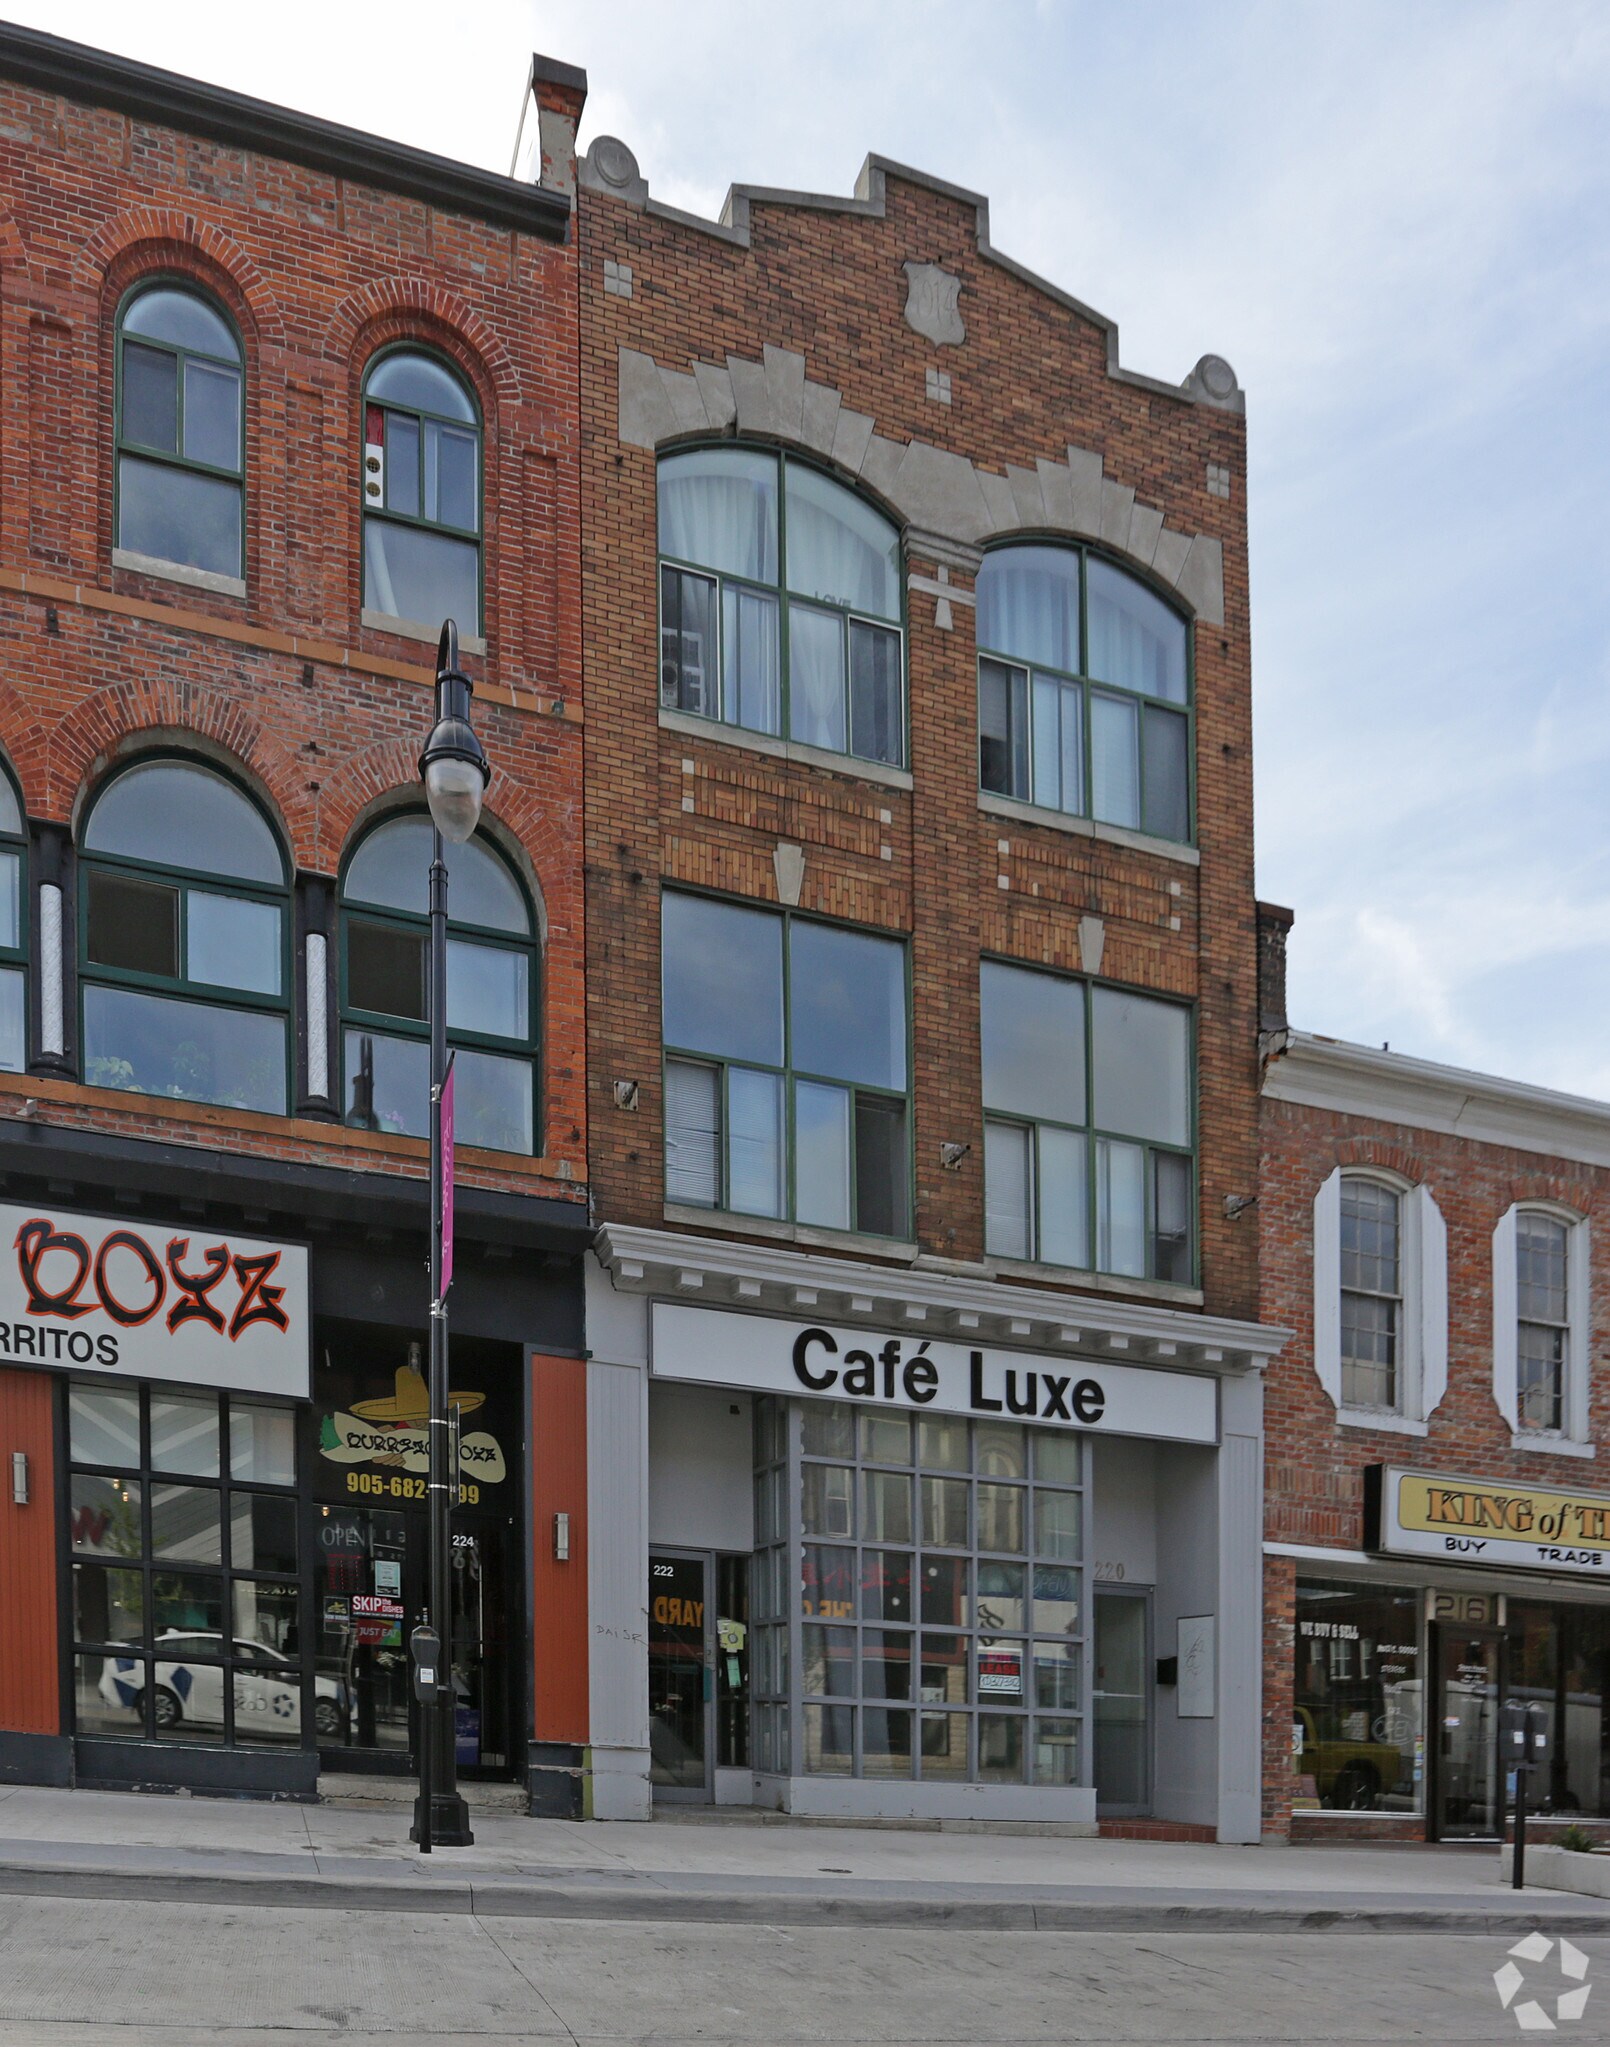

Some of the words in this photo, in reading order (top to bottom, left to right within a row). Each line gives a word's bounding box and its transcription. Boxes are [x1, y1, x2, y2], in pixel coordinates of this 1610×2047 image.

[13, 1218, 290, 1342] BOYZ
[792, 1327, 939, 1403] Café
[970, 1351, 1105, 1424] Luxe
[347, 1472, 479, 1505] 905-682-99
[1426, 1488, 1534, 1532] KING
[1539, 1503, 1571, 1540] of
[321, 1526, 365, 1547] OPEN
[452, 1534, 475, 1547] 224
[1446, 1537, 1487, 1553] BUY
[1537, 1548, 1603, 1565] TRADE
[653, 1564, 674, 1577] 222
[1094, 1560, 1125, 1580] 220
[352, 1595, 382, 1611] SKIP
[1435, 1595, 1485, 1622] 216
[359, 1627, 379, 1636] JUST
[382, 1628, 397, 1637] EAT
[1300, 1621, 1314, 1635] WE
[1314, 1622, 1331, 1637] BUY
[1339, 1624, 1359, 1640] SELL
[980, 1663, 1019, 1675] LEASE
